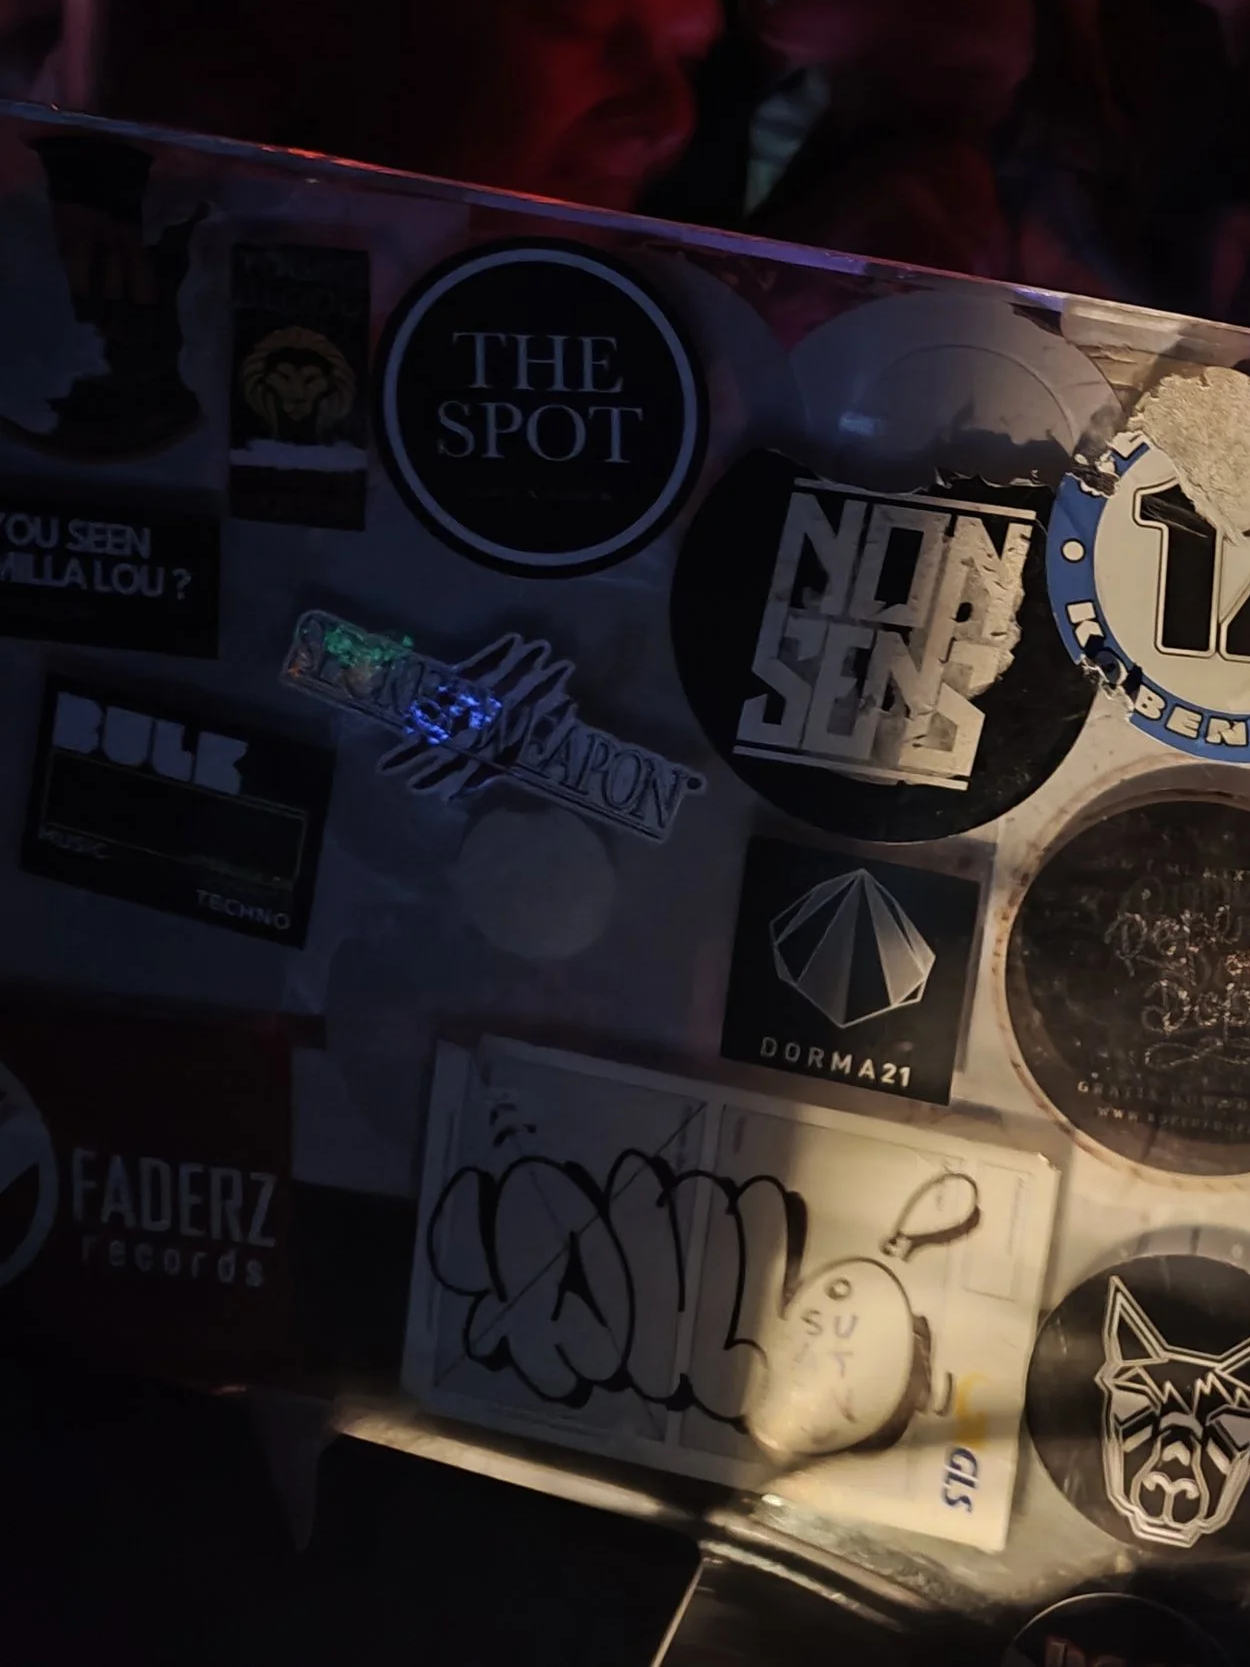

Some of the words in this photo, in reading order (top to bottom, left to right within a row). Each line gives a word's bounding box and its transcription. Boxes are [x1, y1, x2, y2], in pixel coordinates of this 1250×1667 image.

[452, 331, 624, 394] THE
[436, 402, 643, 464] SPOT
[0, 511, 59, 548] OU
[66, 518, 151, 559] SEEN
[52, 691, 249, 795] BULK
[197, 888, 292, 931] TECHNO
[761, 1037, 912, 1089] DORMA21
[71, 1147, 279, 1248] FADERZ
[81, 1236, 266, 1288] records
[943, 1445, 979, 1513] GLS
